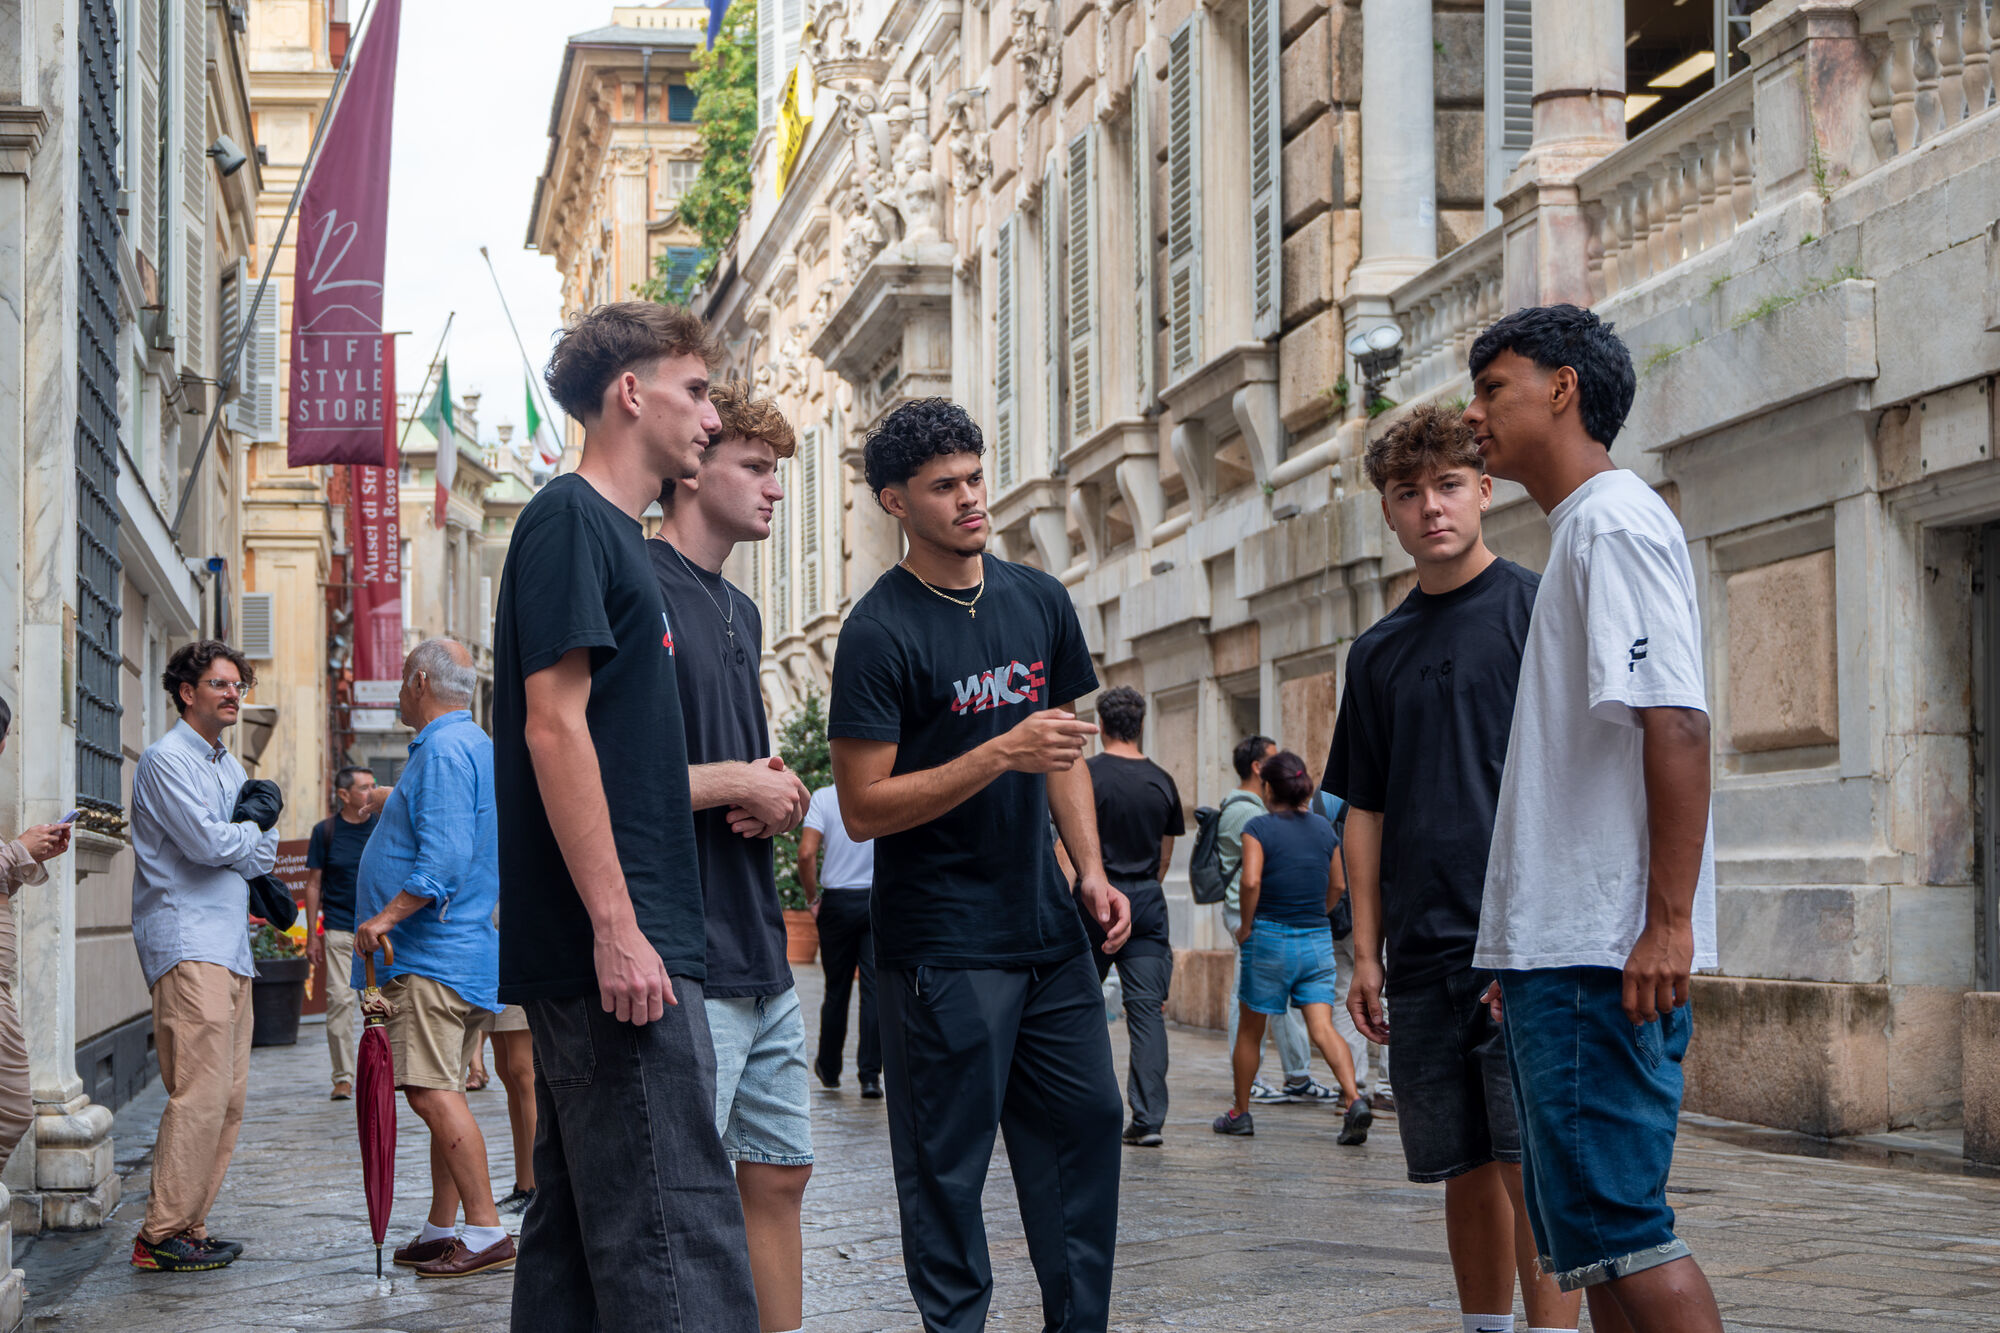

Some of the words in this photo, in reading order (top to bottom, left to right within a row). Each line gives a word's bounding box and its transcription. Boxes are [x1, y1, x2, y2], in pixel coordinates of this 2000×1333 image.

[299, 339, 383, 363] LIFE
[299, 369, 383, 392] STYLE
[298, 399, 382, 422] STORE
[361, 466, 377, 496] Str
[382, 467, 397, 517] Rosso
[362, 501, 378, 519] di
[363, 525, 380, 582] Musei
[383, 522, 398, 583] Palazzo
[275, 854, 308, 864] Gelater
